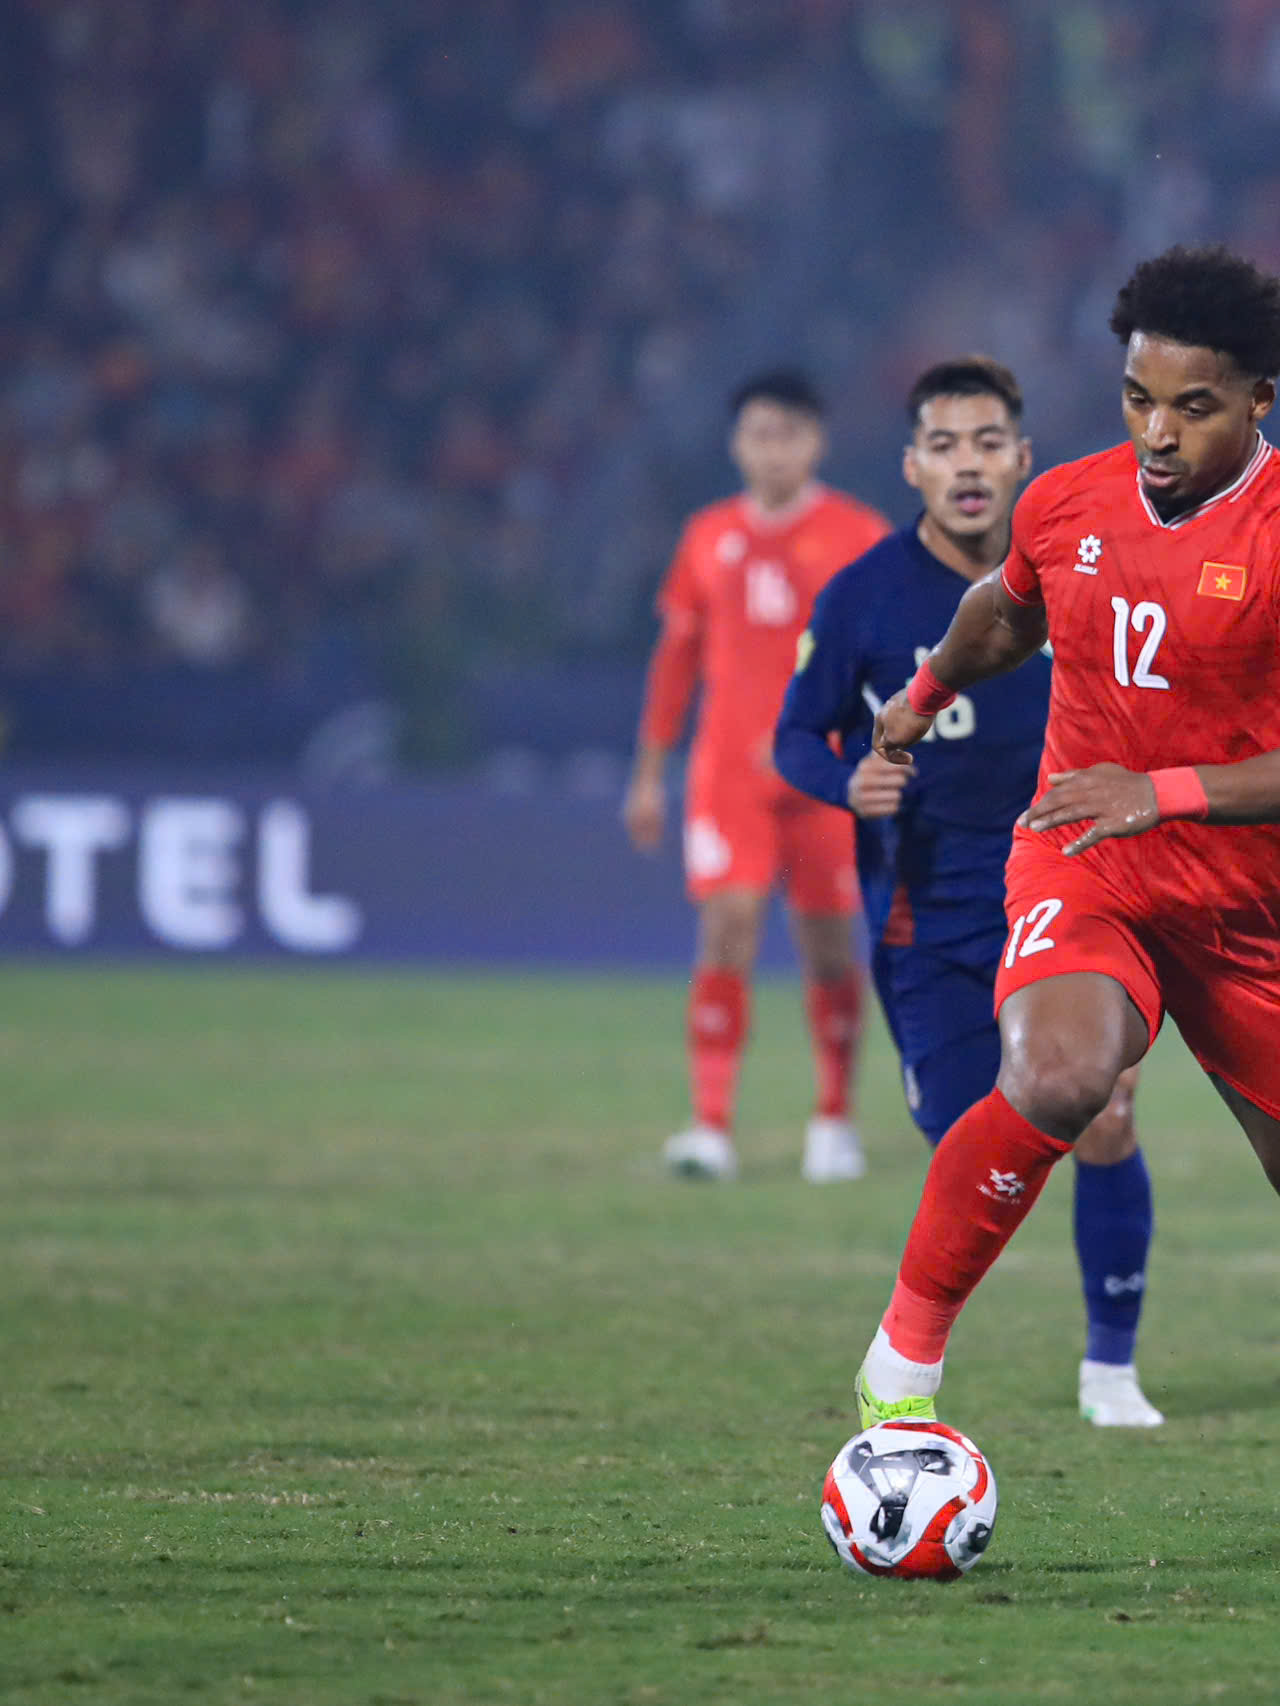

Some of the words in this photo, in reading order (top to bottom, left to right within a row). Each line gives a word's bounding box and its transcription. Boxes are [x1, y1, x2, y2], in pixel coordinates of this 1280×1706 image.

[1111, 596, 1170, 690] 12
[920, 693, 977, 741] 6
[0, 797, 362, 951] TEL
[1004, 898, 1064, 969] 12
